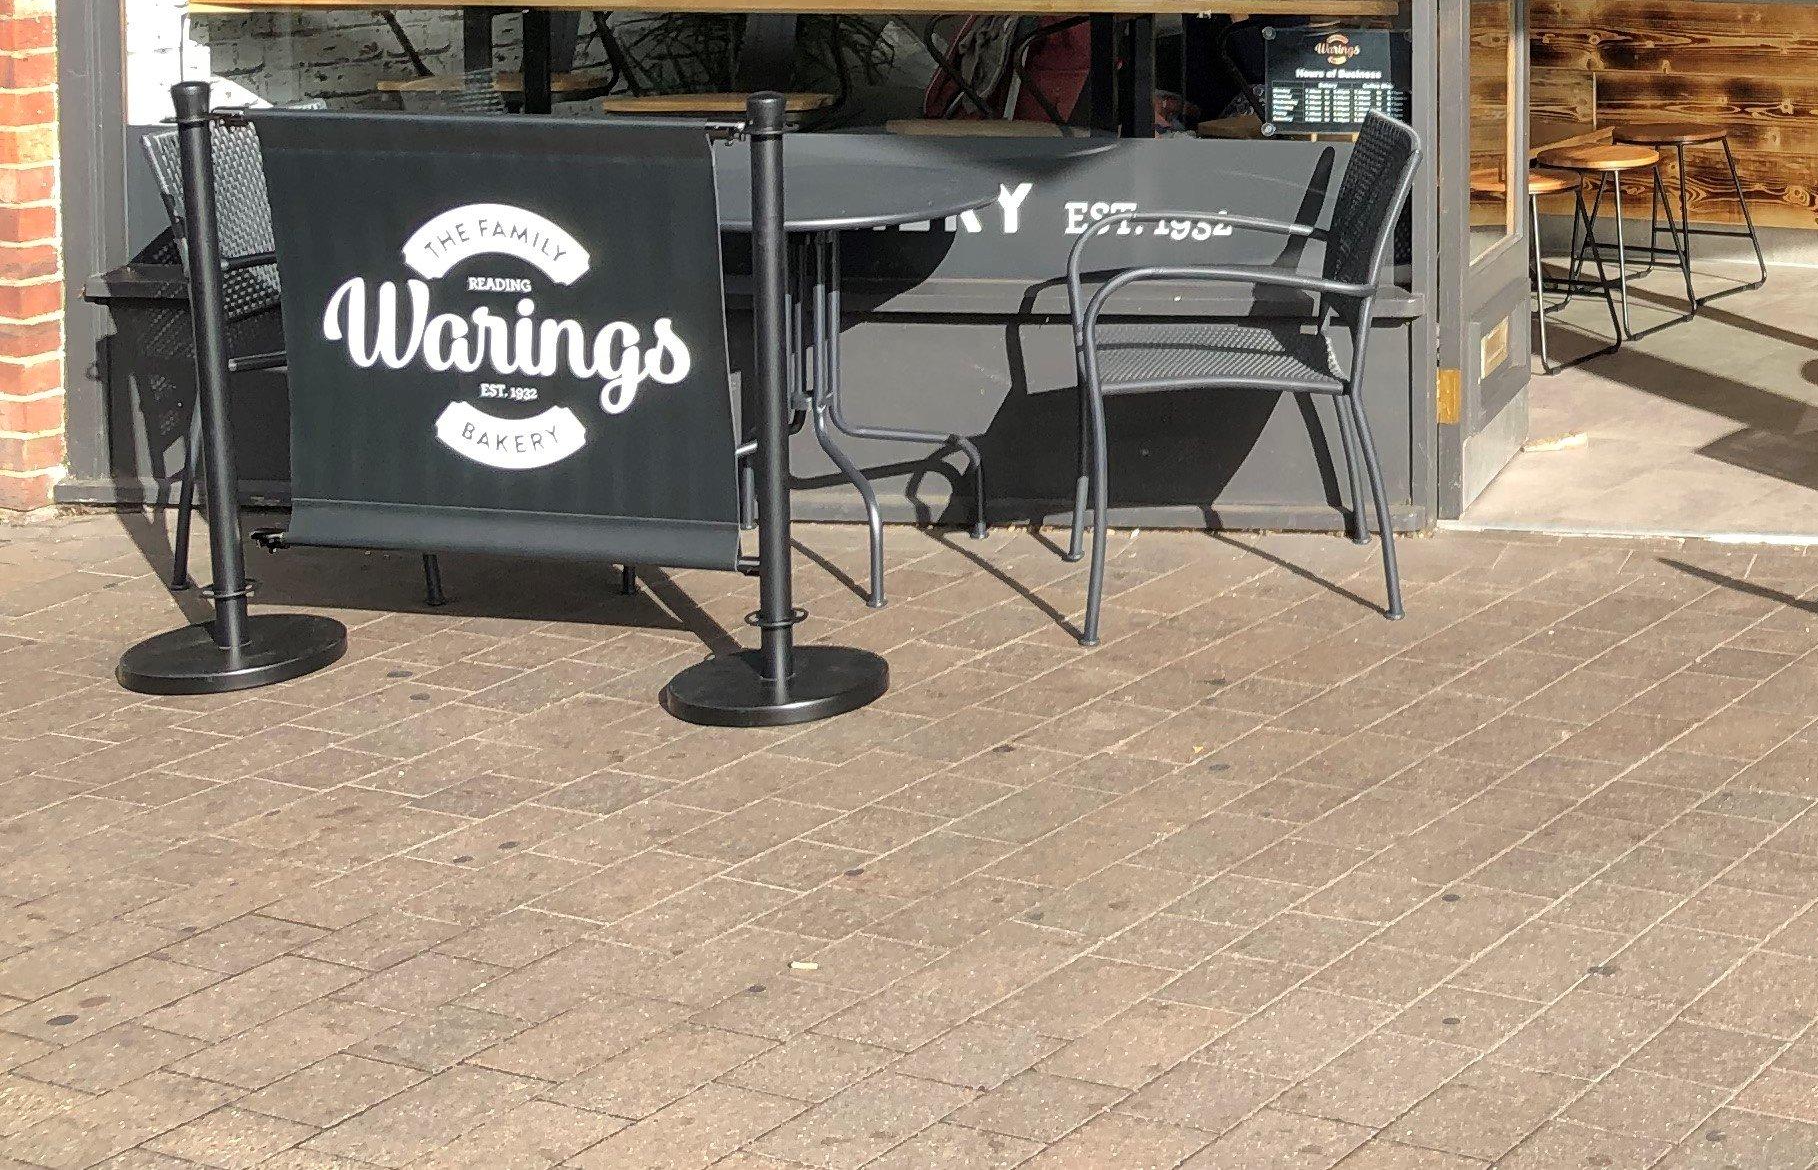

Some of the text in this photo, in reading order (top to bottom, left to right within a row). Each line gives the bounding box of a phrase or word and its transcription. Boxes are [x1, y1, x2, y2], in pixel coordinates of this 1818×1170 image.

[1295, 67, 1383, 80] Hours of Business
[1064, 201, 1145, 236] EST.
[424, 218, 567, 261] THE FAMILY
[467, 276, 532, 293] READING
[322, 276, 691, 415] Warings
[479, 383, 538, 401] EST. 1932
[461, 421, 559, 454] BAKERY
